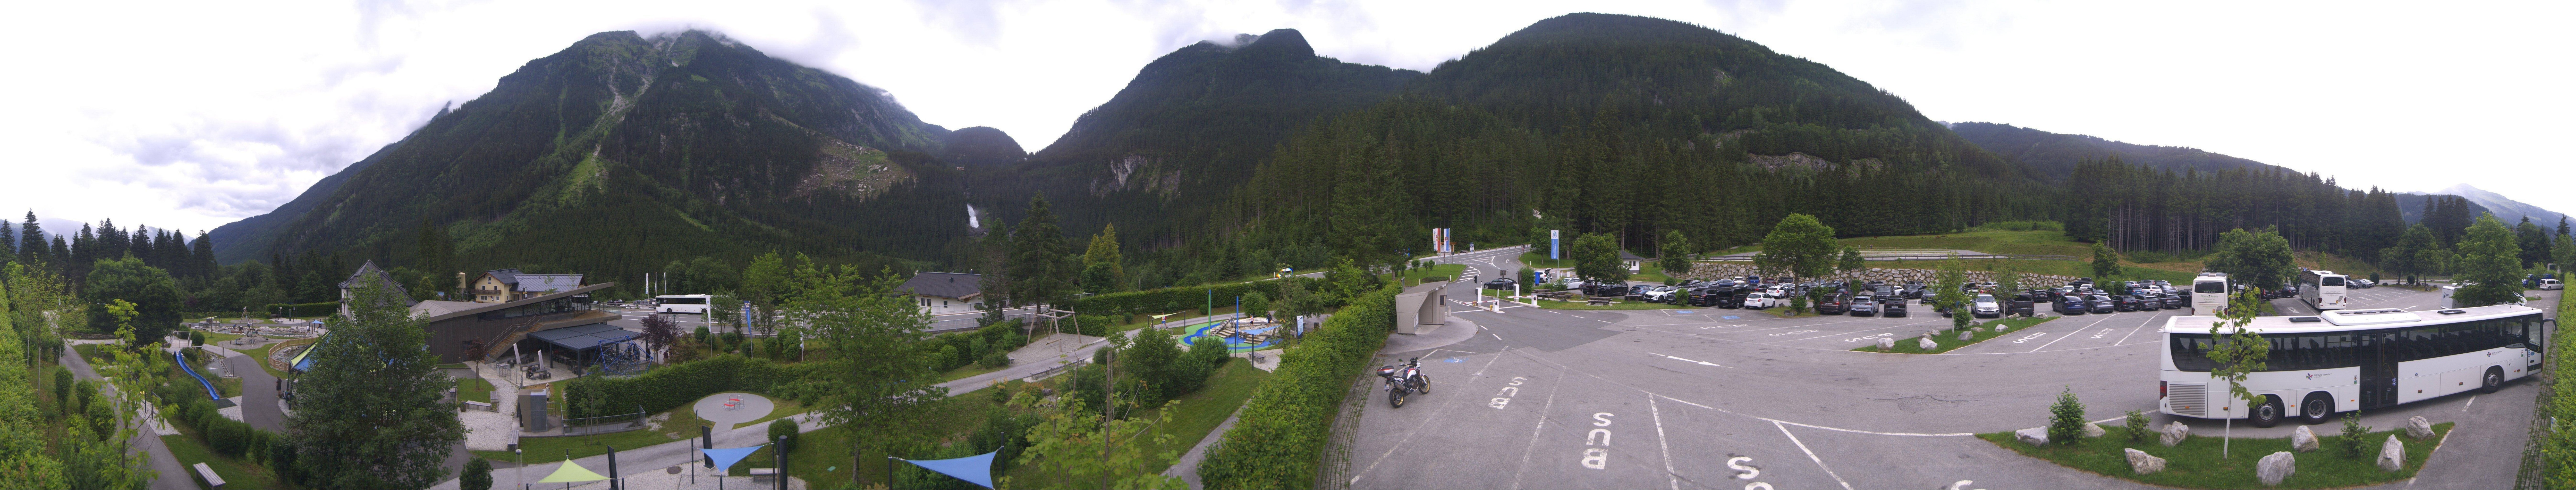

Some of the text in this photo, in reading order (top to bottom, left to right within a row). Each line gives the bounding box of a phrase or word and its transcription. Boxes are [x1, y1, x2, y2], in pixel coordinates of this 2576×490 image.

[1845, 333, 1893, 342] BUS
[2013, 332, 2046, 343] BUS
[2090, 328, 2113, 338] BUS
[1488, 377, 1527, 409] BUS
[1581, 412, 1614, 469] BUS
